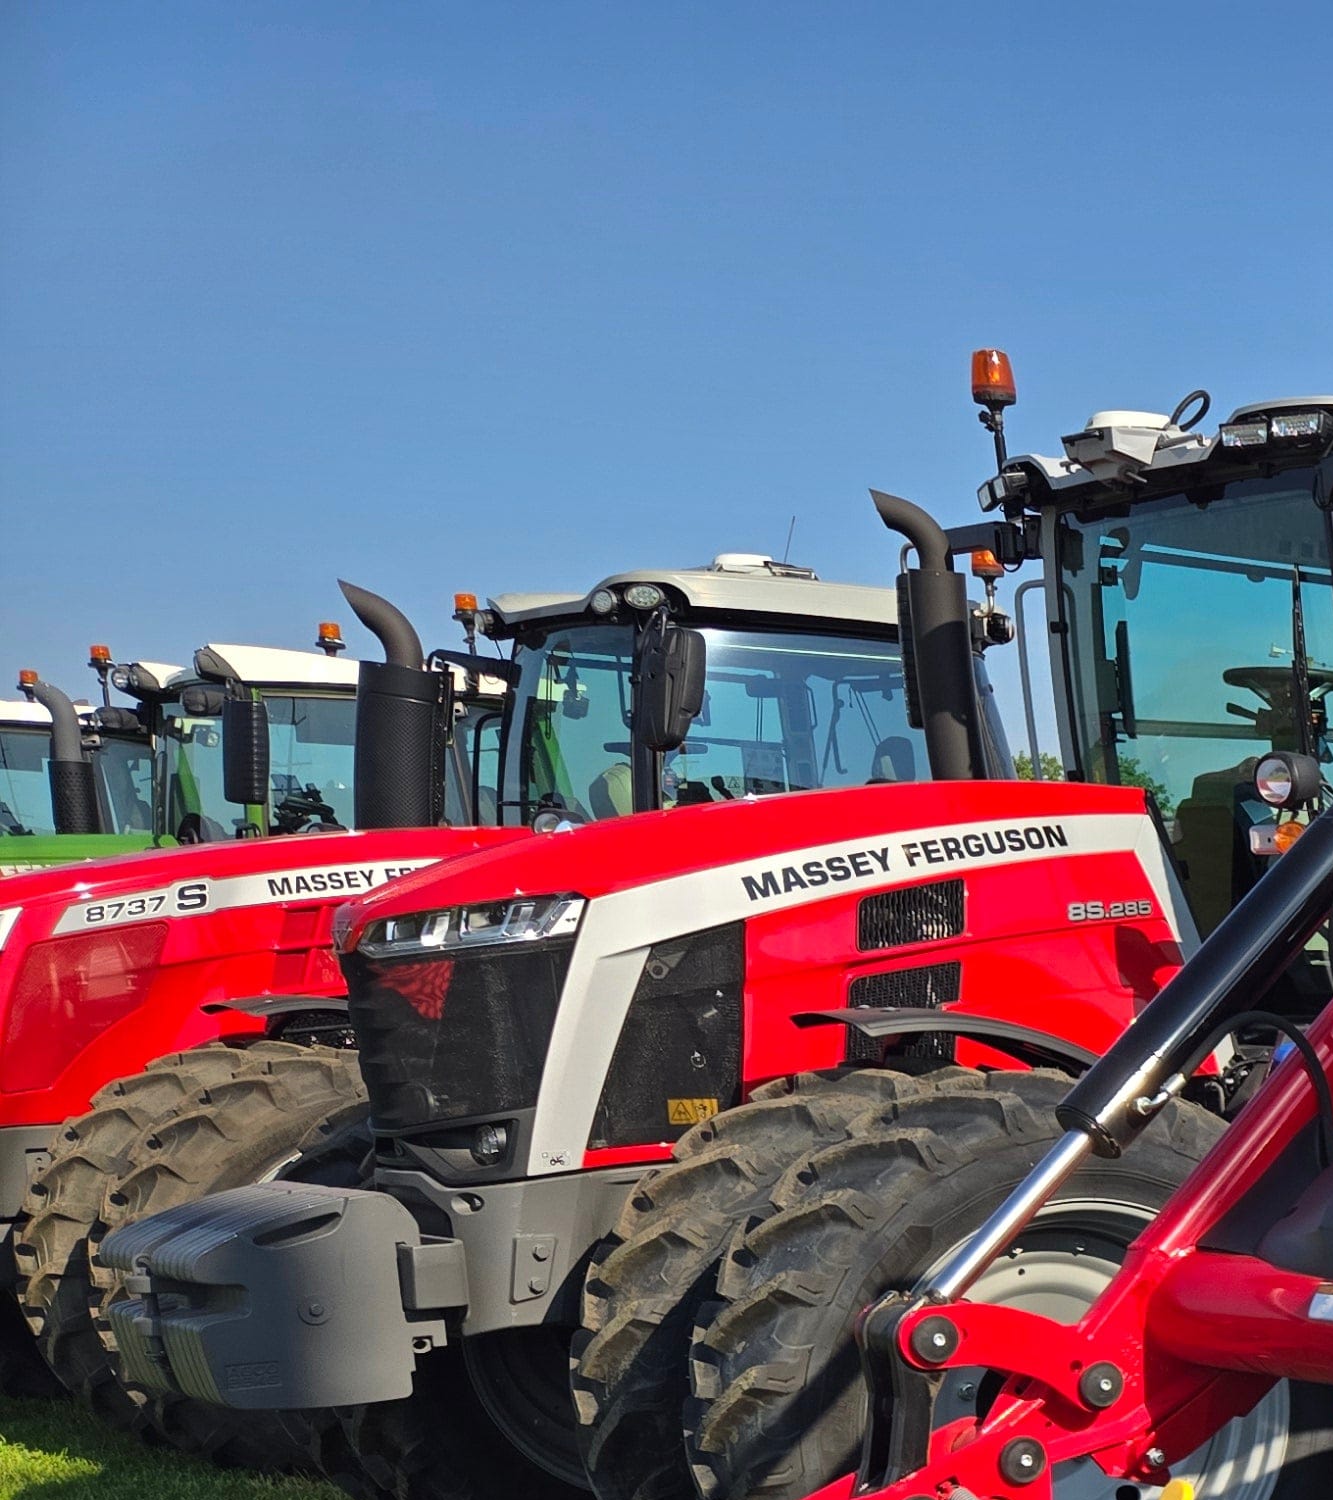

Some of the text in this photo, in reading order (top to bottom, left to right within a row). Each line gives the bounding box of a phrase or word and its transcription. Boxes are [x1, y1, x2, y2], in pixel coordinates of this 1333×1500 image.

[742, 824, 1068, 902] MASSEY FERGUSON
[86, 895, 166, 922] 8737
[177, 884, 208, 910] S
[267, 869, 374, 896] MASSEY
[1067, 900, 1153, 921] 8S.285
